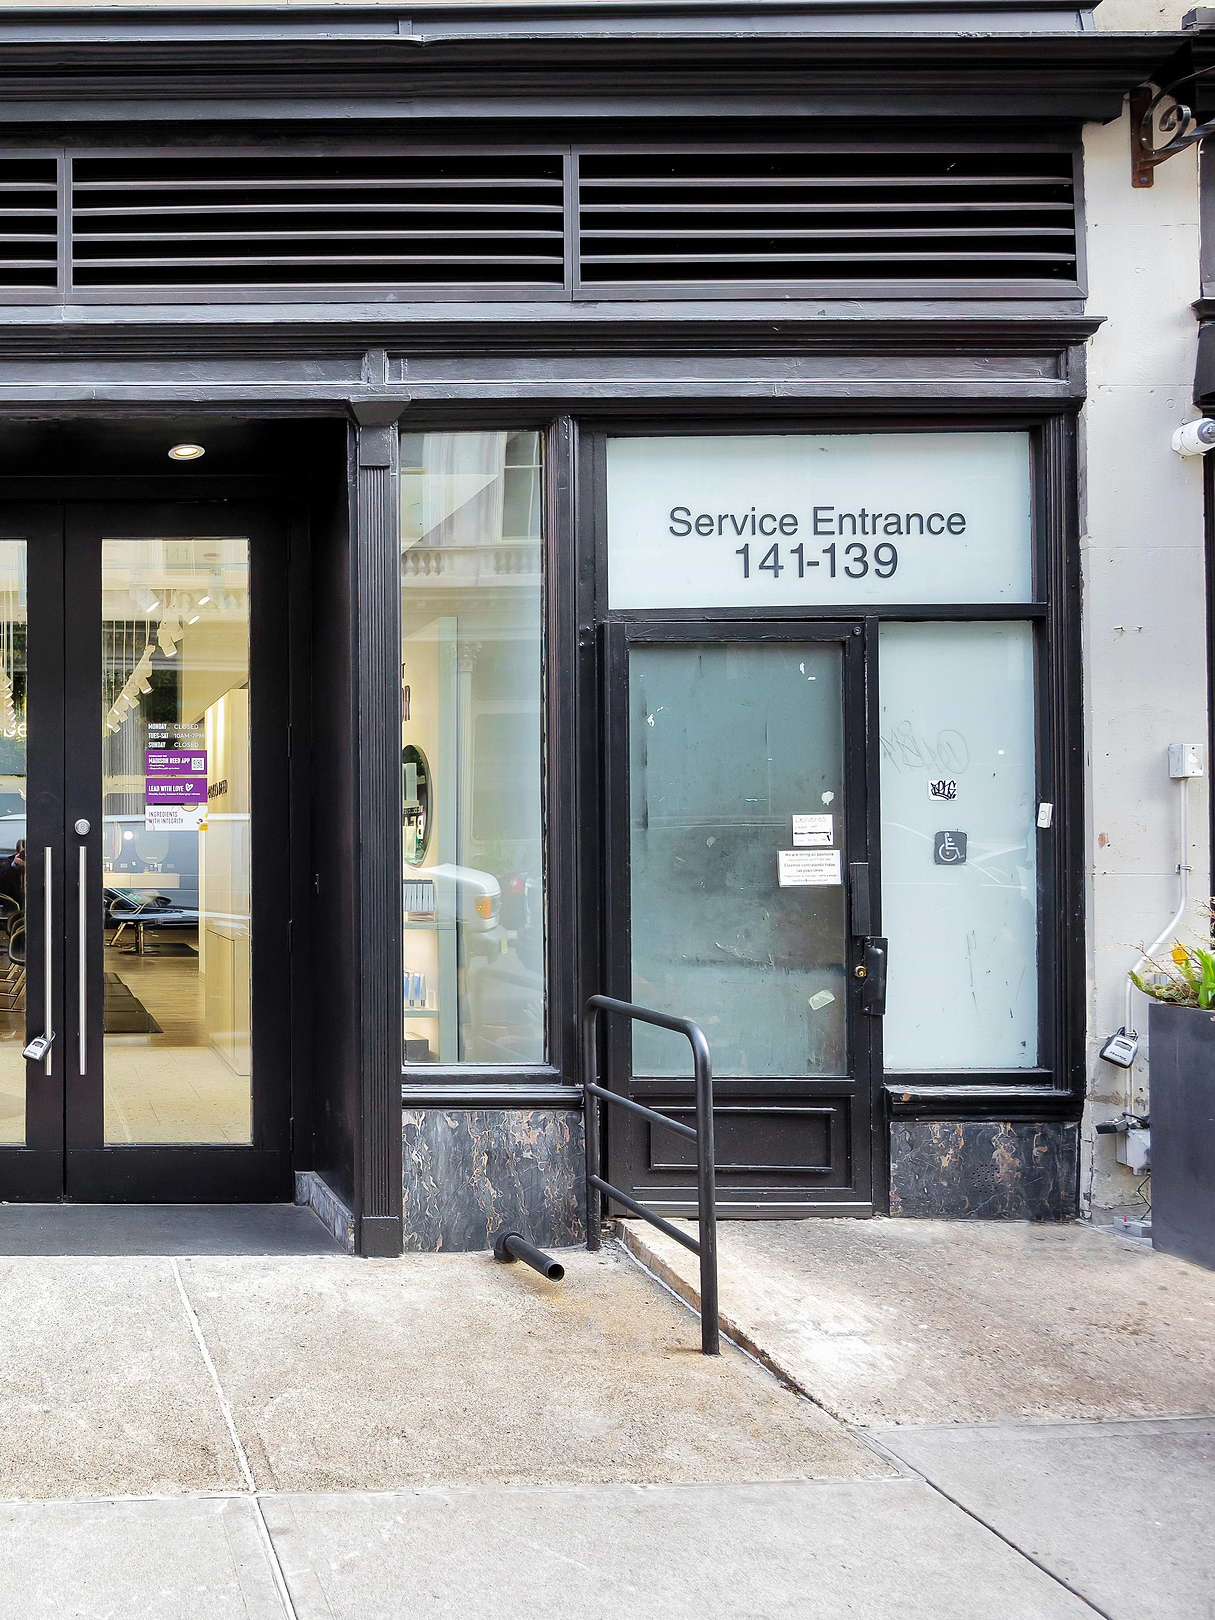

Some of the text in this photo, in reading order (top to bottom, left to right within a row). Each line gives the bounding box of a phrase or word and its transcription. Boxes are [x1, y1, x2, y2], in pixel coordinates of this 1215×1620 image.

[669, 506, 967, 536] Service Entrance
[735, 541, 899, 578] 141-139
